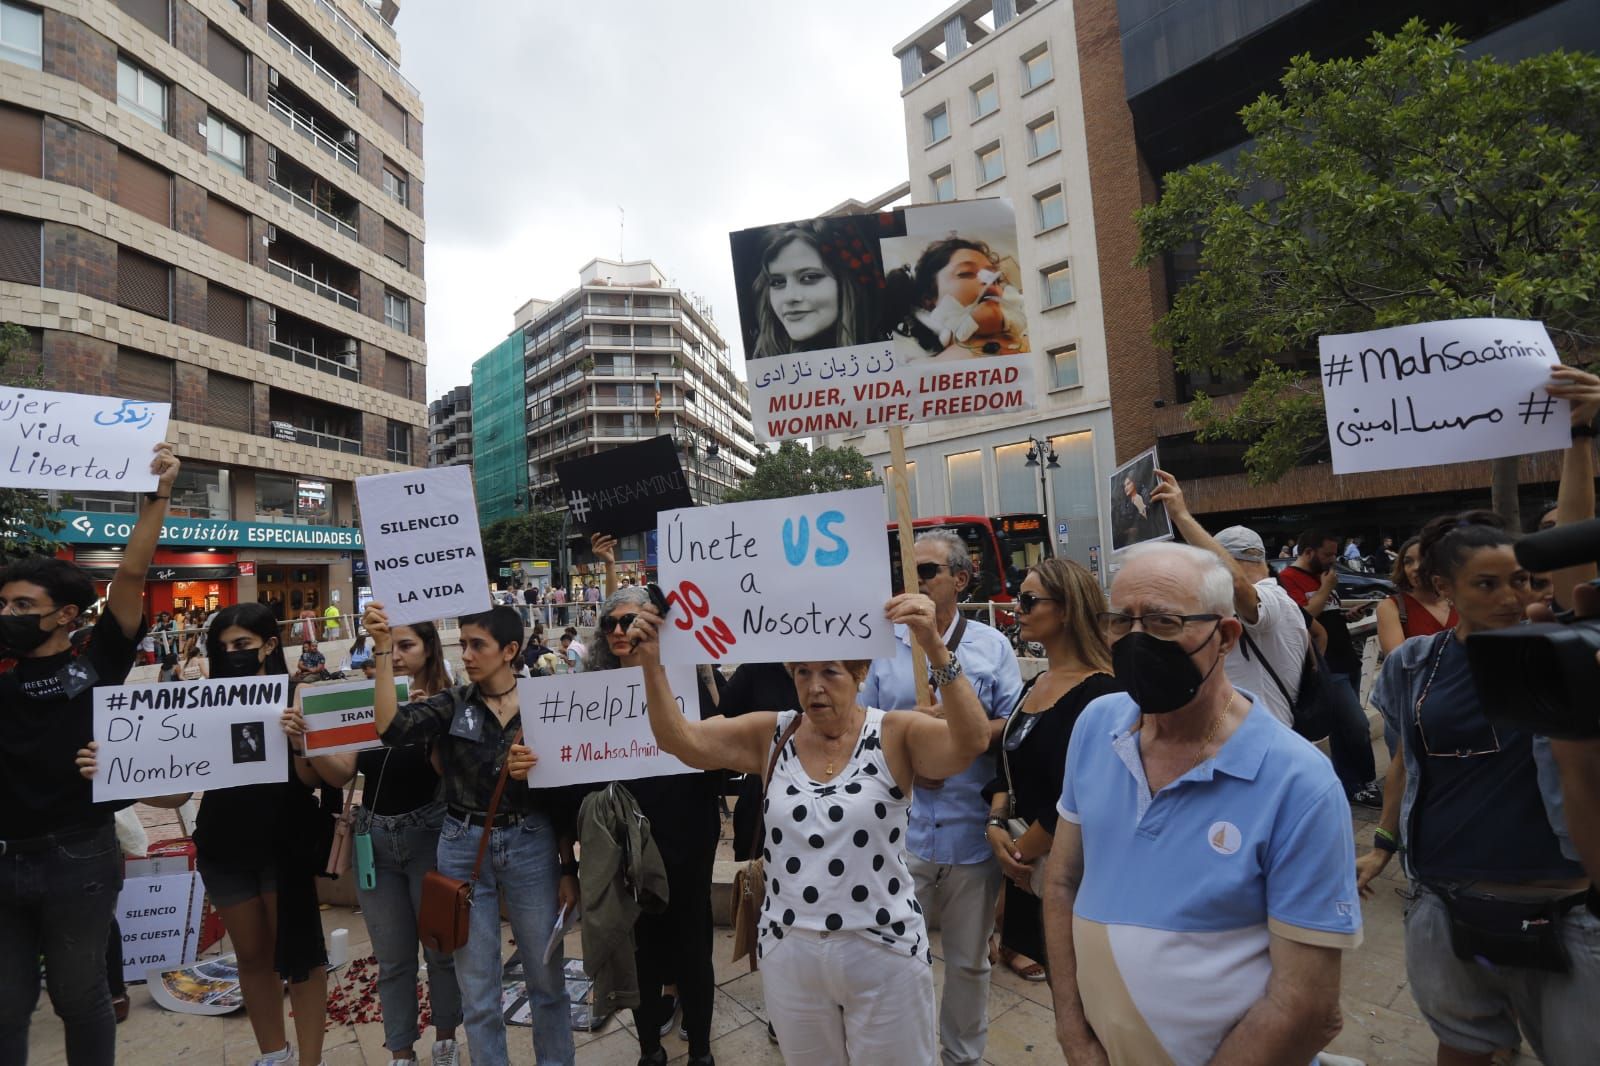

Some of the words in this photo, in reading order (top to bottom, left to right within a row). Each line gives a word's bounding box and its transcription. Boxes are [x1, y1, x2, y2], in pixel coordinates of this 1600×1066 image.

[866, 349, 894, 374] ژن
[768, 388, 846, 413] MUJER,
[853, 379, 911, 401] VIDA,
[919, 366, 1019, 394] LIBERTAD
[767, 413, 858, 438] WOMAN,
[866, 403, 914, 425] LIFE,
[922, 390, 1023, 417] FREEDOM
[20, 422, 80, 447] Vida
[9, 446, 130, 480] Libertad
[404, 483, 425, 496] TU
[569, 471, 684, 523] #MAHSAAMINI
[104, 522, 239, 541] coacvisión
[248, 528, 351, 545] ESPECIALIDADES
[380, 513, 459, 535] SILENCIO
[667, 513, 759, 564] Únete
[781, 510, 850, 568] US
[374, 555, 409, 571] NOS
[414, 546, 476, 565] CUESTA
[398, 590, 418, 604] LA
[422, 583, 464, 599] VIDA
[740, 572, 762, 594] a
[743, 601, 872, 639] Nosotrxs
[106, 682, 282, 711] #MAHSAAMINI
[107, 715, 144, 742] Di
[157, 713, 197, 742] Su
[340, 709, 374, 723] IRAN
[107, 754, 211, 785] Nombre
[148, 884, 162, 893] TU
[125, 906, 177, 919] SILENCIO
[121, 933, 138, 943] OS
[140, 929, 180, 941] CUESTA
[123, 958, 136, 967] LA
[140, 954, 166, 964] VIDA
